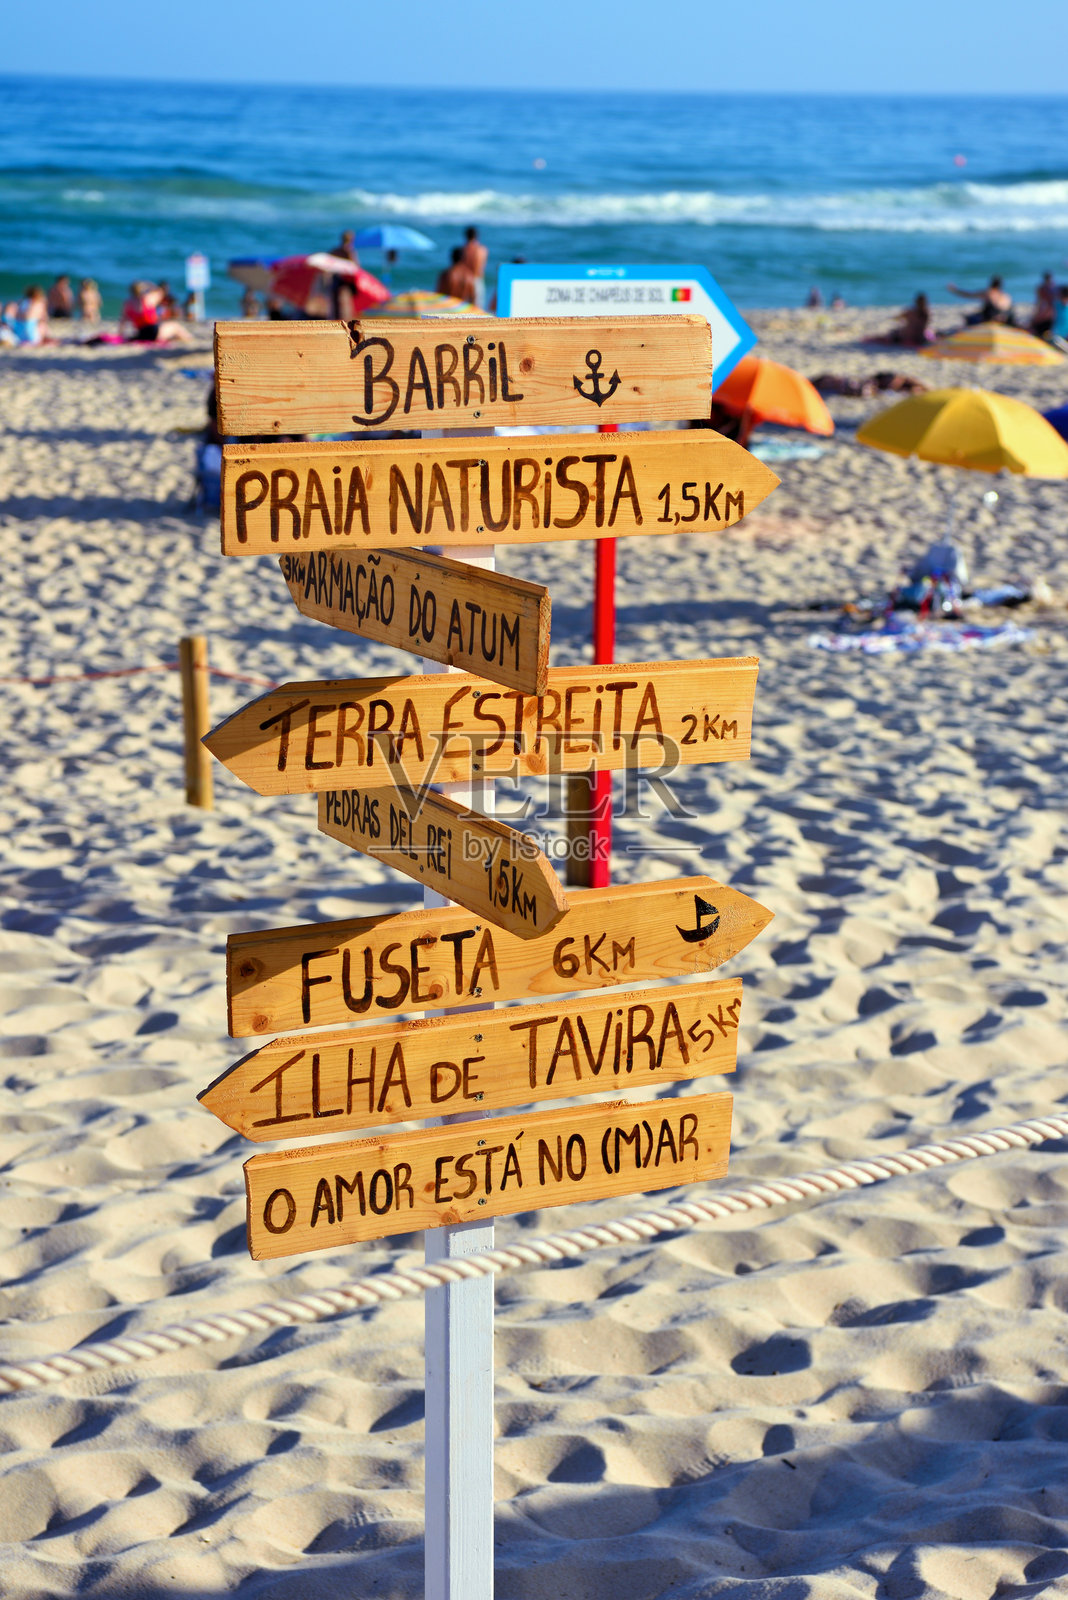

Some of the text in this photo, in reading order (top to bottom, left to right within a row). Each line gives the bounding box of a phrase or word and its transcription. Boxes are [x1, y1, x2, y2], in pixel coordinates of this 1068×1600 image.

[304, 551, 395, 628] ARMAÇÃO
[408, 584, 437, 643] DO
[447, 598, 520, 671] ATUM
[259, 698, 424, 772] TERRA
[326, 789, 381, 839] PEDRAS
[390, 802, 418, 860] DEL
[302, 928, 500, 1024] FUSETA
[250, 1042, 412, 1127] ILHA
[430, 1056, 485, 1103] DE
[263, 1113, 699, 1234] O AMOR ESTÁ NO (M)AR
